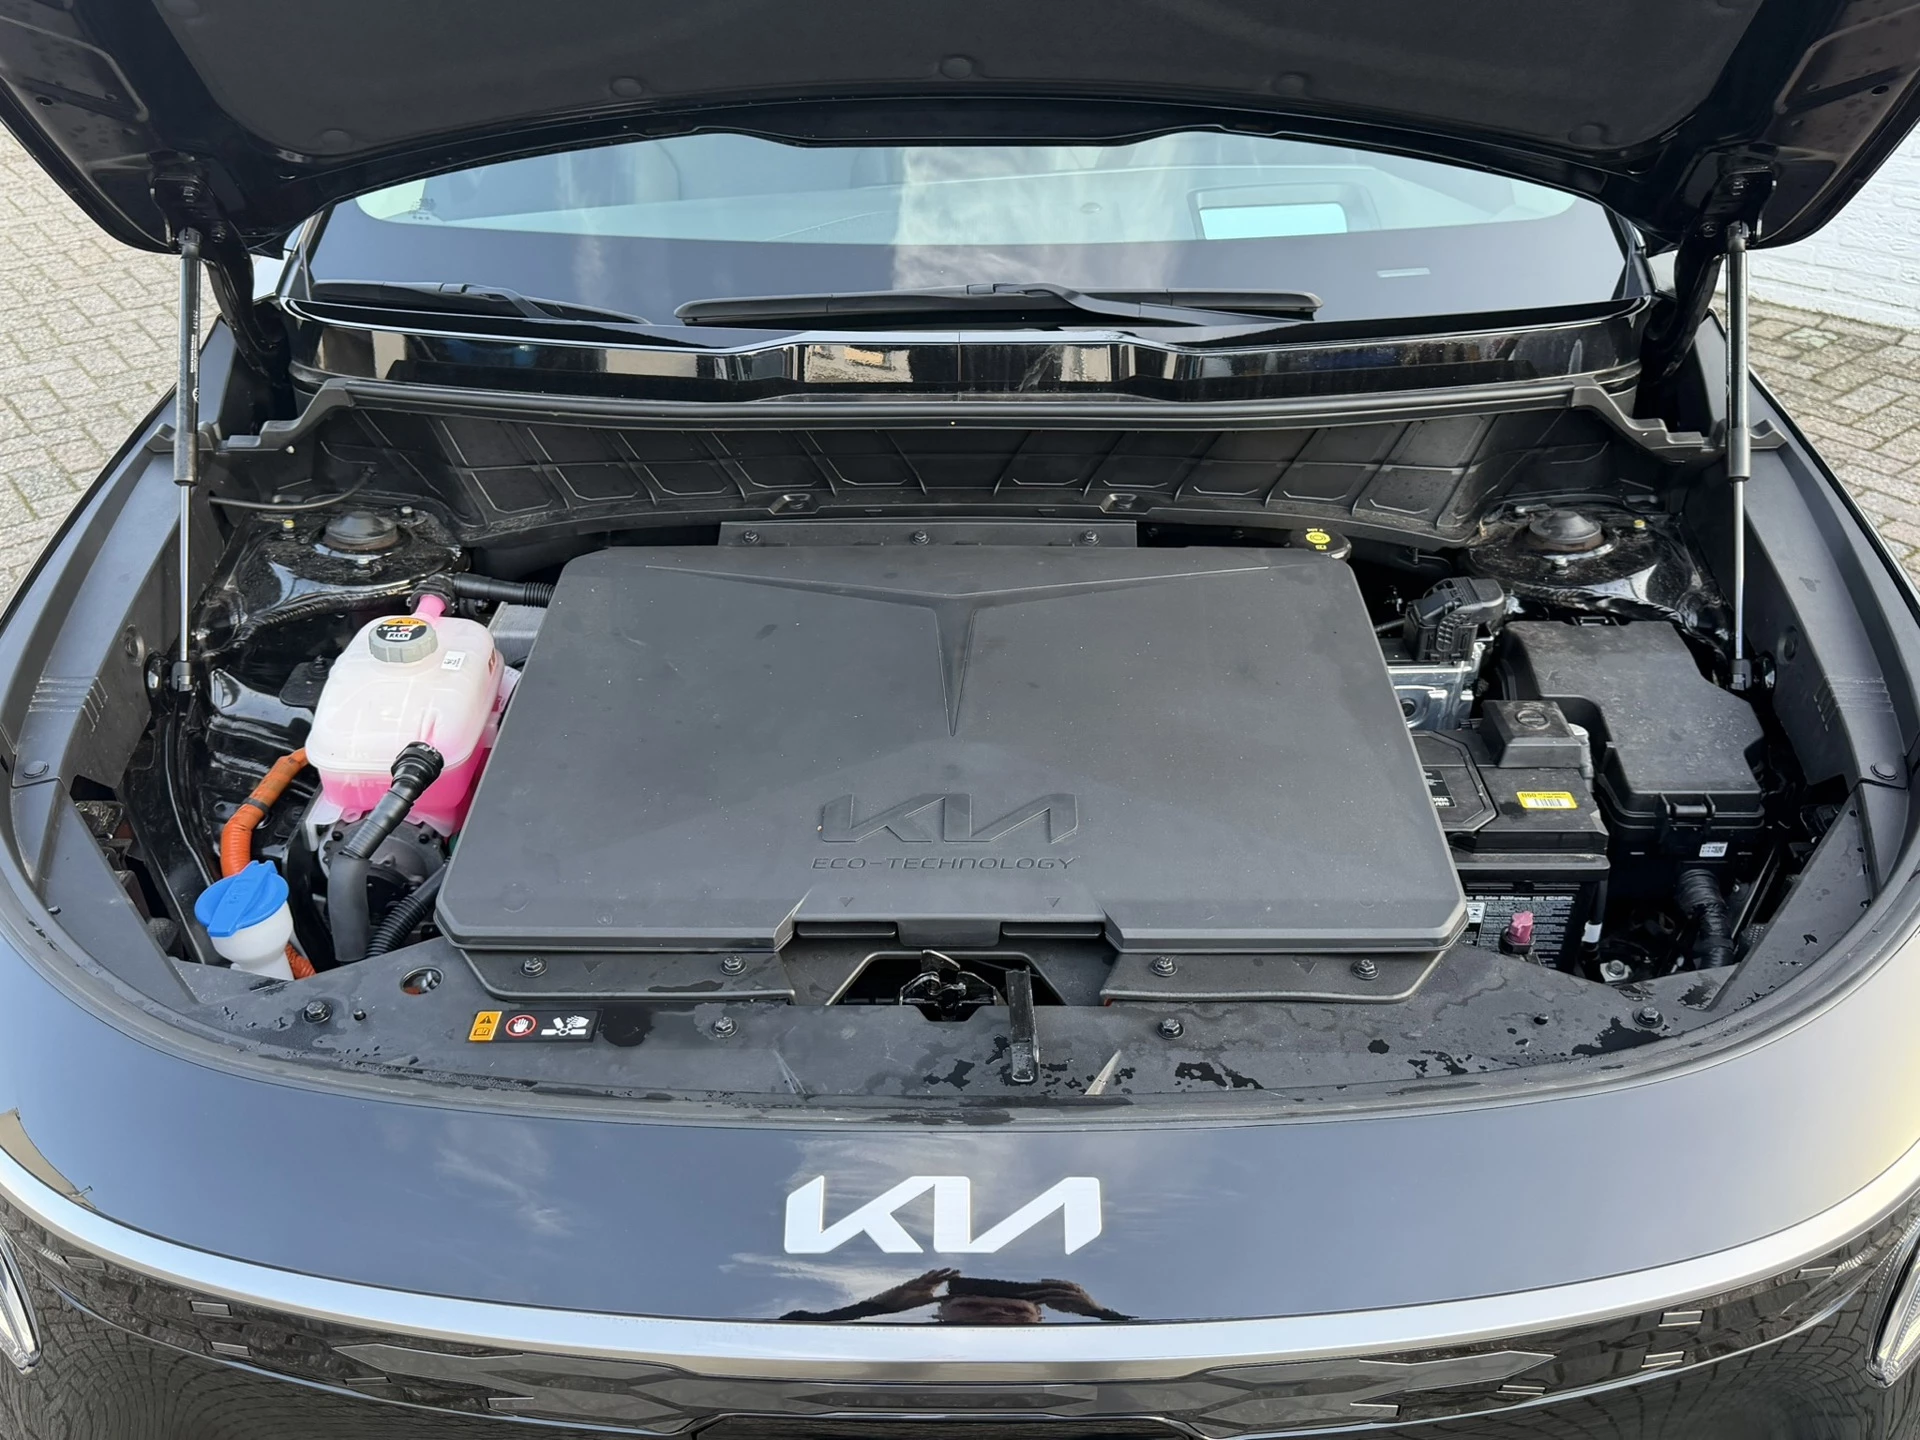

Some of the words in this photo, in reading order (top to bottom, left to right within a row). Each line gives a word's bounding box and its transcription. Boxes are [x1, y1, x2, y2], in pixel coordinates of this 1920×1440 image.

[822, 793, 1079, 844] KIA
[811, 857, 1076, 870] ECO-TECHNOLOGY
[784, 1175, 1102, 1255] KIA
